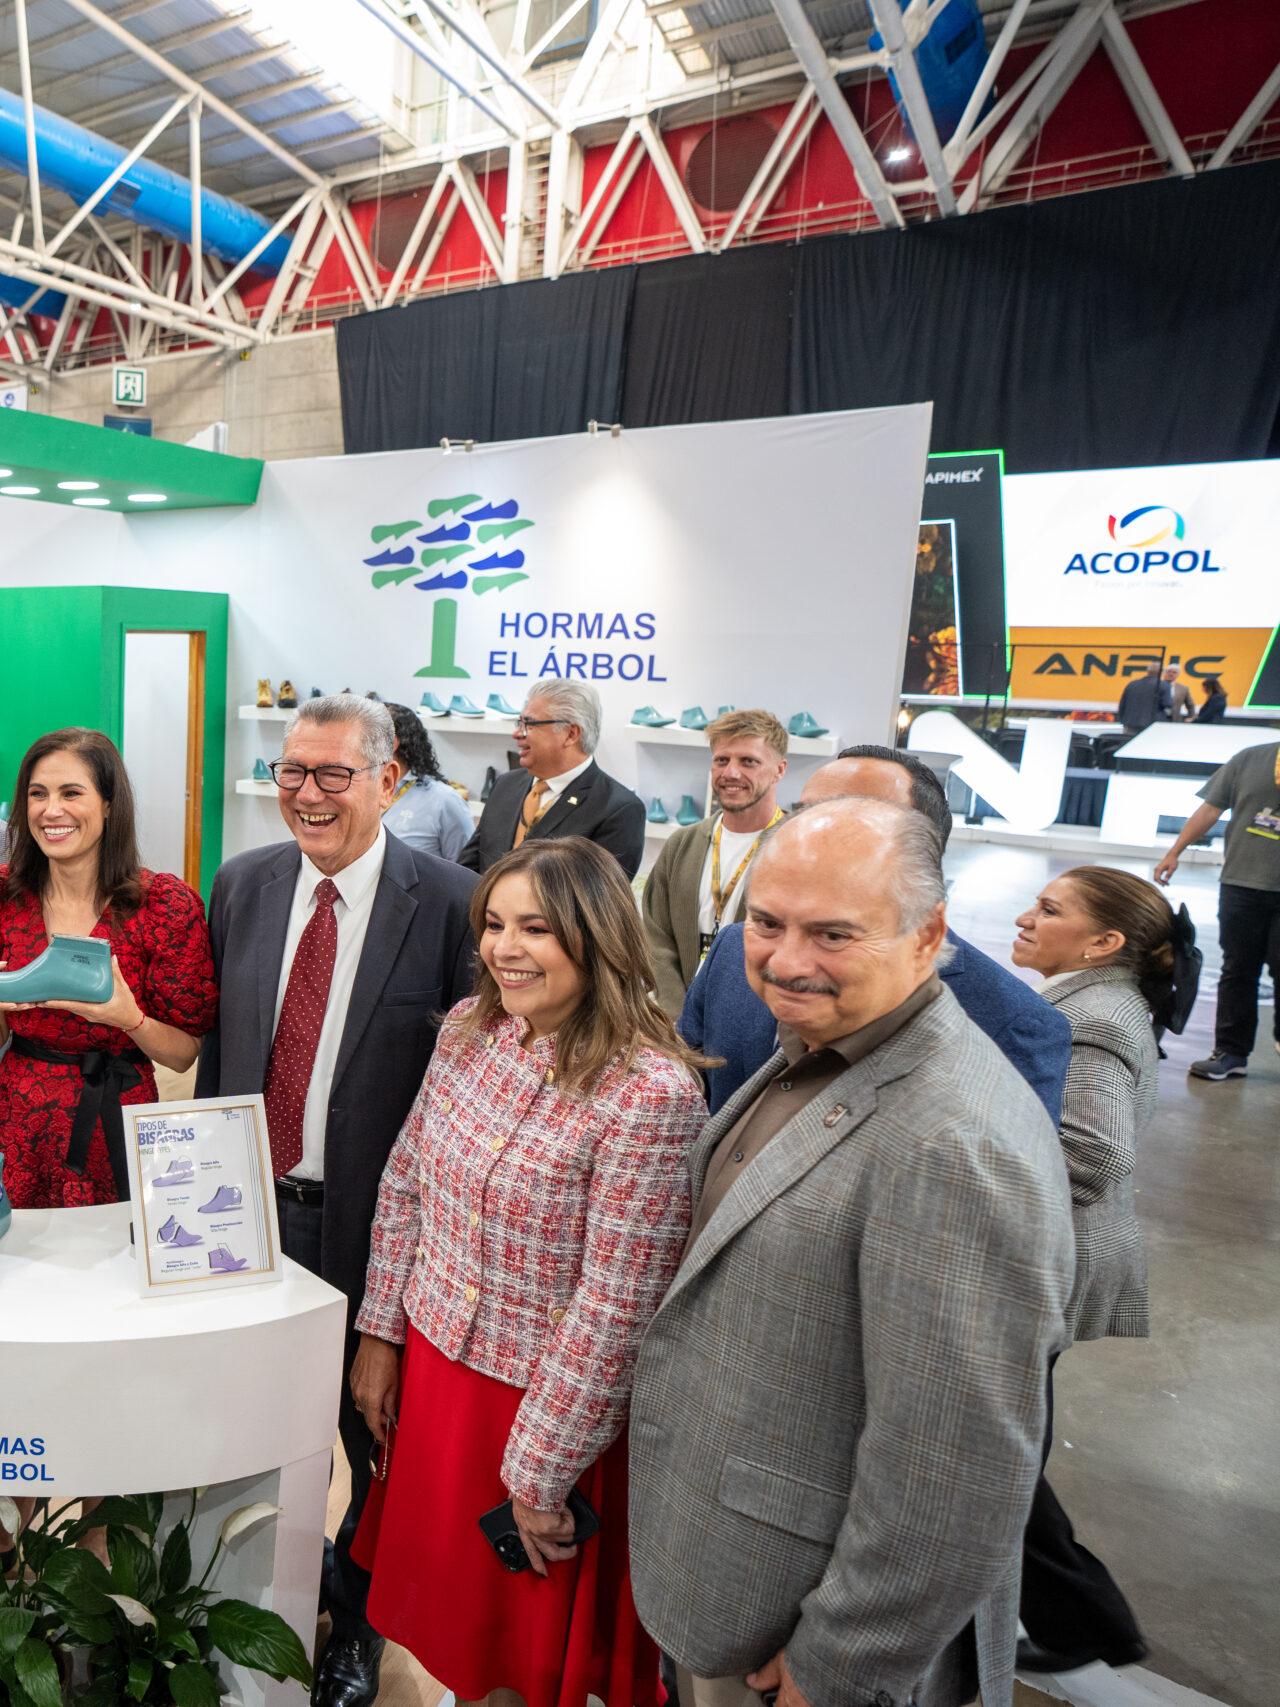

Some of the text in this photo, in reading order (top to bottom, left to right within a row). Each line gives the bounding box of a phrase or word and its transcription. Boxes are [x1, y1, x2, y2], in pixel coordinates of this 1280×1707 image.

[924, 467, 984, 484] APIMEX
[1064, 550, 1220, 575] ACOPOL
[500, 612, 656, 640] HORMAS
[488, 646, 667, 682] EL ÁRBOL
[137, 1120, 167, 1131] TIPOS DE
